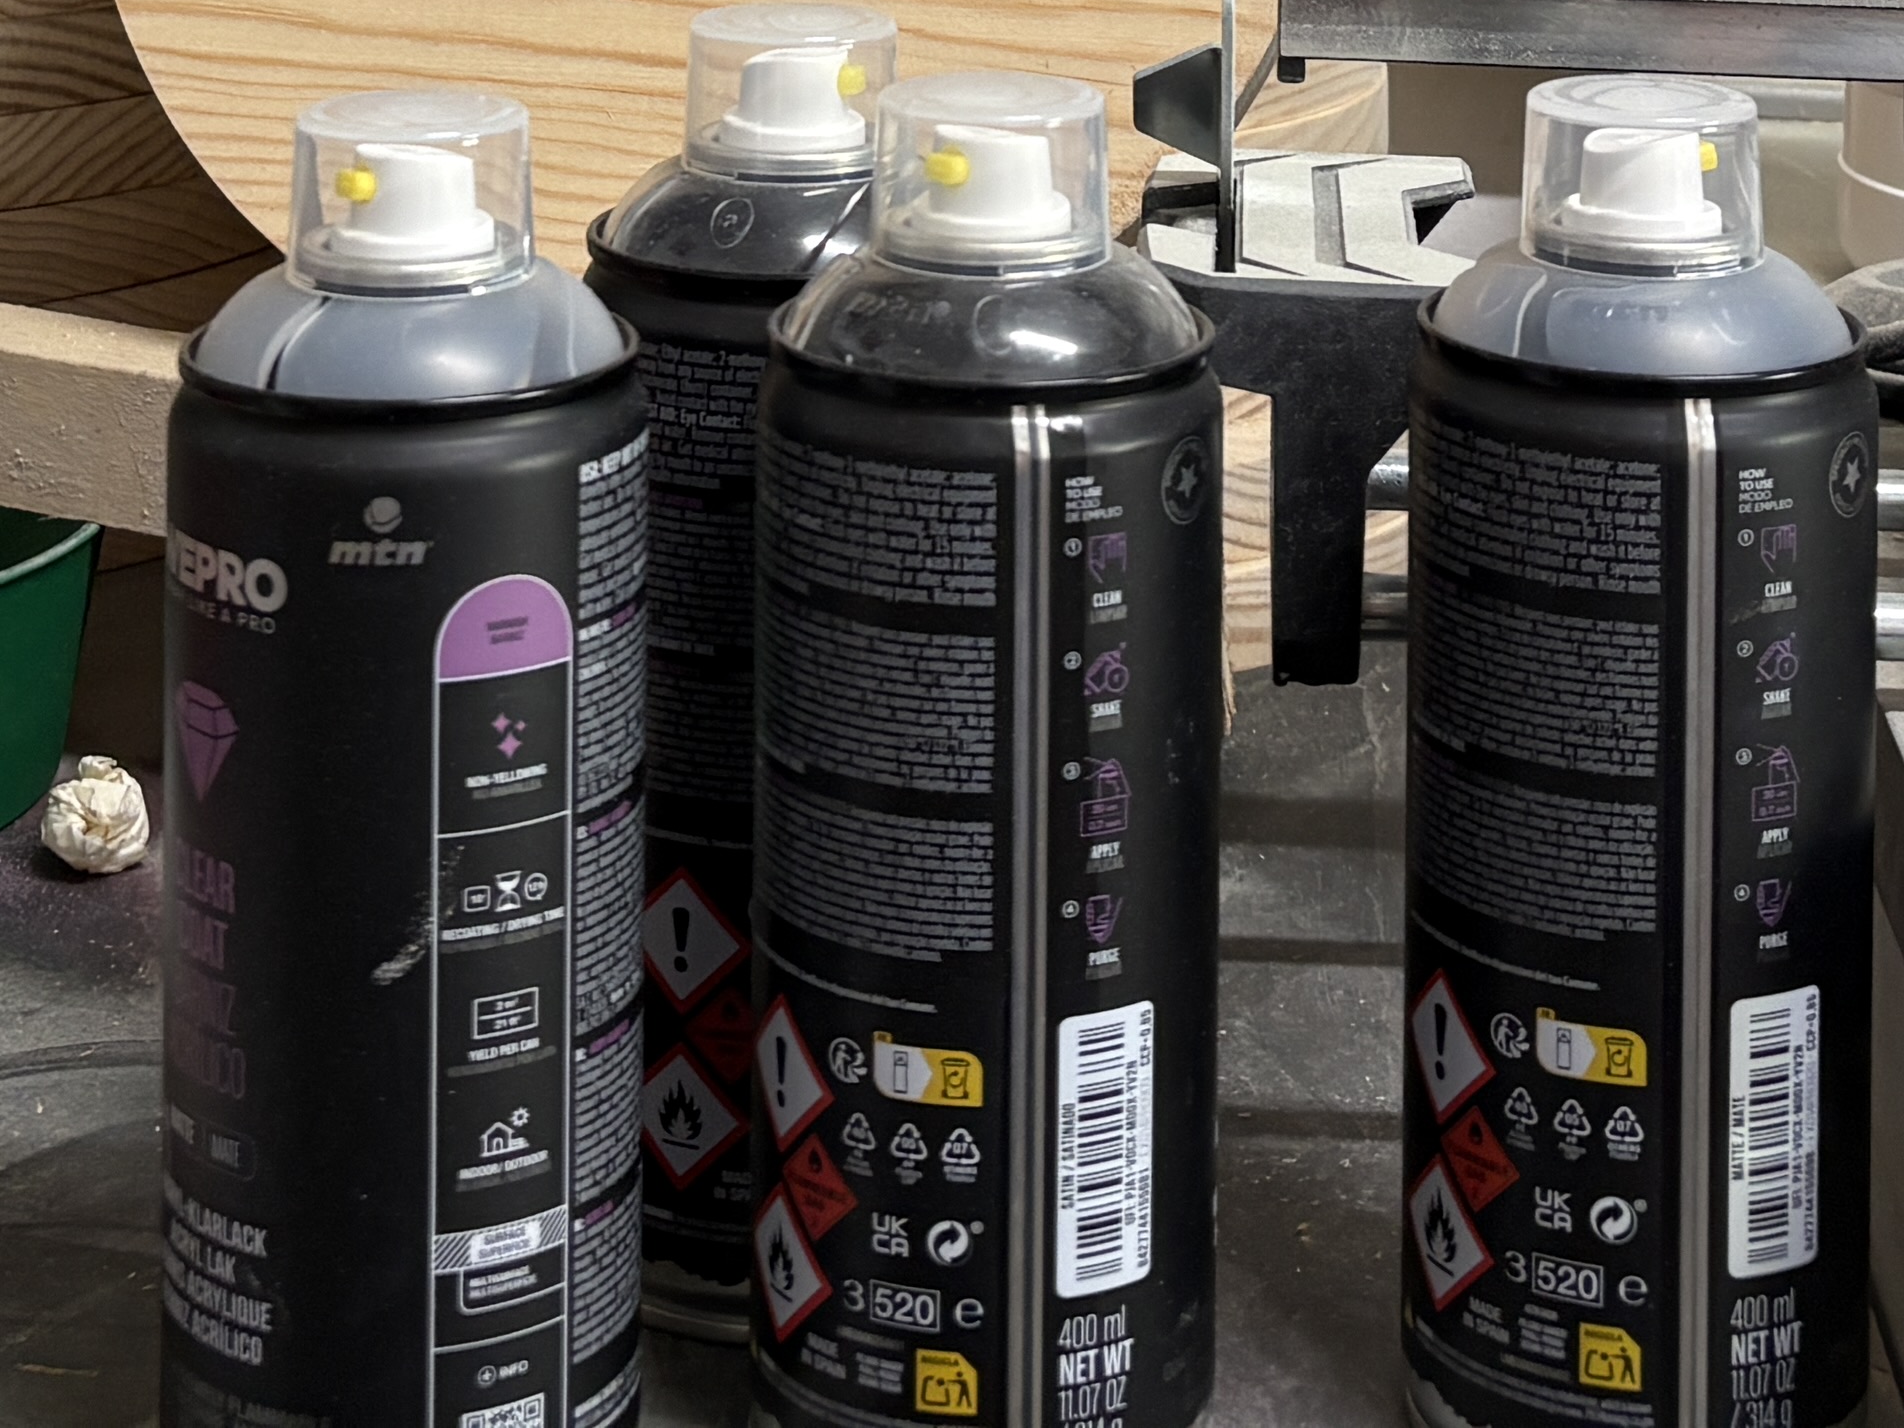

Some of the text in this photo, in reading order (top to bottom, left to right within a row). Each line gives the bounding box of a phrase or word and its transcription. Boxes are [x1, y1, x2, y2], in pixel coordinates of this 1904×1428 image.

[1065, 476, 1095, 488] HOW
[1739, 468, 1767, 480] HOW
[1739, 478, 1774, 491] TO USE
[1065, 498, 1100, 510] MODO
[1066, 486, 1103, 499] TO USE
[1739, 490, 1772, 502] MODO
[1739, 498, 1794, 513] DE EMPLEO
[1600, 524, 1614, 541] 15
[328, 539, 429, 566] mtn
[1093, 590, 1122, 607] CLEAN
[1765, 581, 1792, 597] CLEAN
[236, 613, 276, 634] PRO
[1763, 688, 1791, 705] SHAKE
[1761, 827, 1789, 844] APPLY
[1090, 842, 1121, 860] APPLY
[1759, 931, 1788, 949] PURGE
[1088, 947, 1121, 966] PURGE
[1732, 1096, 1745, 1127] MATE
[1061, 1102, 1076, 1162] SATINADO
[1616, 1120, 1631, 1132] 07
[1731, 1137, 1745, 1181] MATTE
[1061, 1174, 1076, 1210] SATIN
[1535, 1186, 1572, 1212] UK
[872, 1212, 909, 1237] UK
[1535, 1208, 1573, 1234] CA
[872, 1234, 910, 1258] CA
[206, 1247, 236, 1284] LAK
[1504, 1250, 1647, 1306] 3 520 e
[187, 1270, 273, 1333] ACRYLIQUE
[843, 1279, 985, 1329] 3 520 e
[1730, 1286, 1795, 1330] 400 ml
[1058, 1304, 1125, 1349] 400 ml
[1731, 1320, 1803, 1366] NET WT
[499, 1359, 529, 1379] INFO
[1059, 1338, 1135, 1387] NET WT
[1730, 1357, 1796, 1401] 11.07 OZ
[1058, 1375, 1127, 1421] 11.07 OZ
[1746, 1397, 1776, 1428] 314
